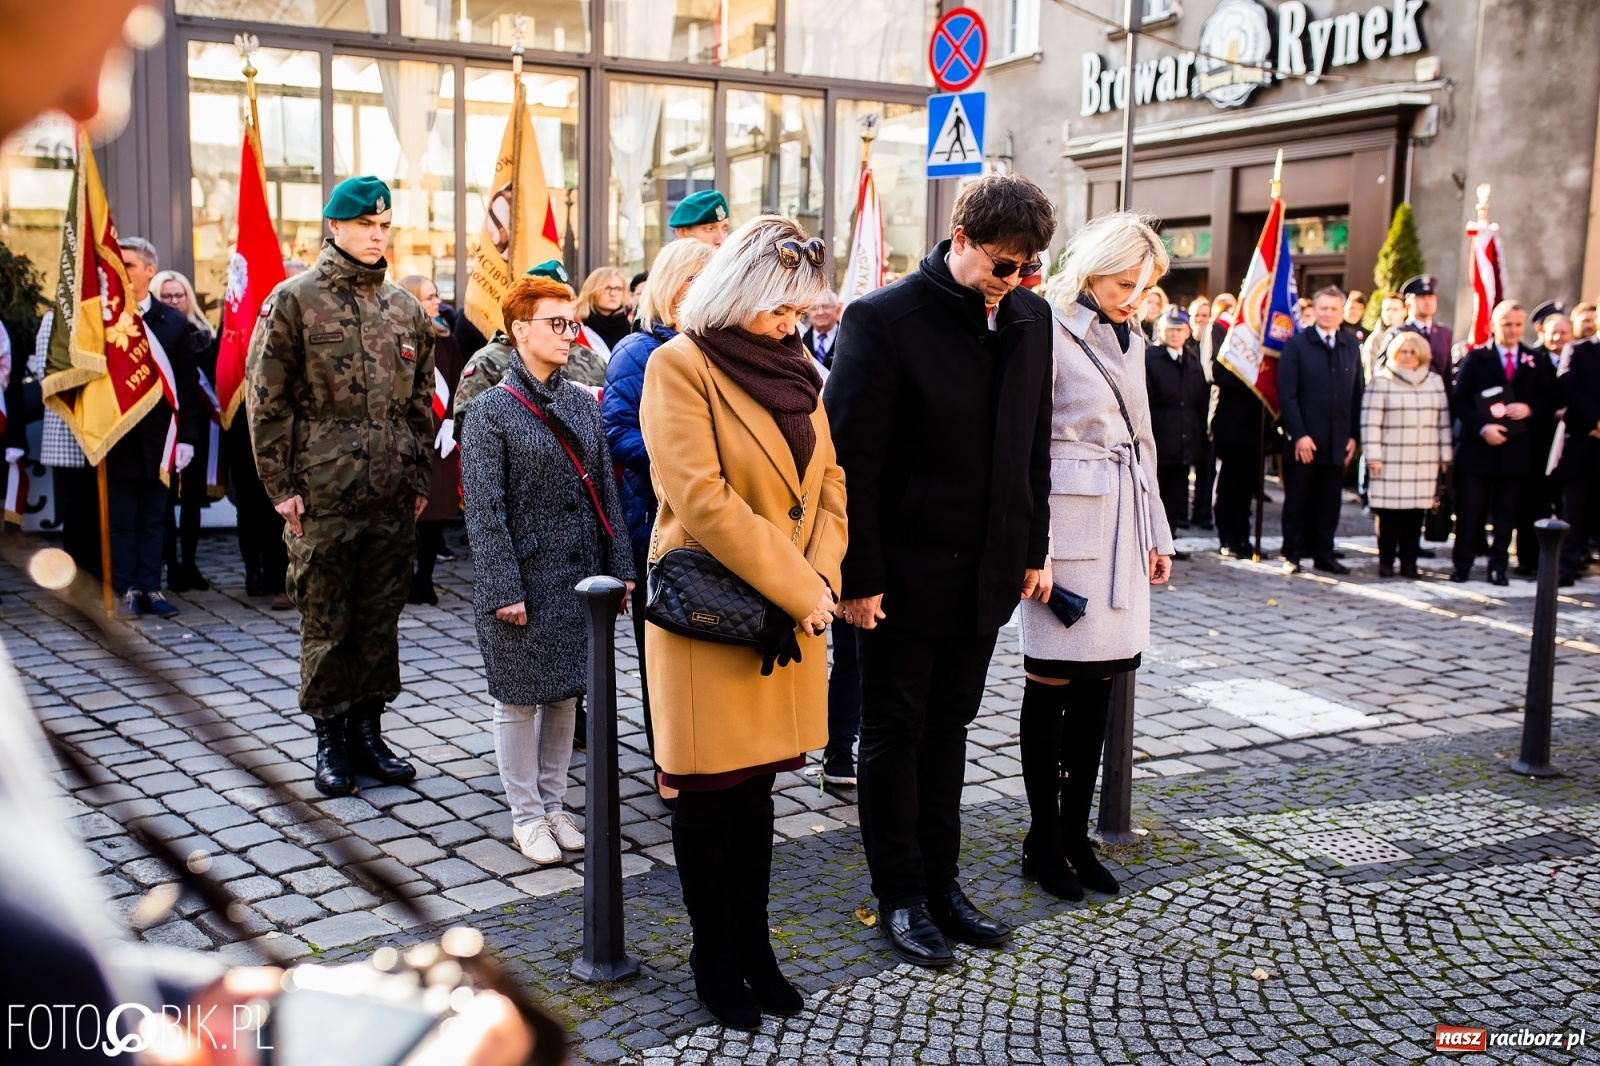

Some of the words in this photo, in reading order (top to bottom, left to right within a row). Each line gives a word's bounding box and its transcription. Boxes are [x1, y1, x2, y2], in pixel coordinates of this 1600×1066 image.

[1080, 51, 1196, 117] Browar
[1275, 0, 1425, 86] Rynek
[471, 269, 501, 303] OŻENIA
[125, 364, 151, 391] 1920
